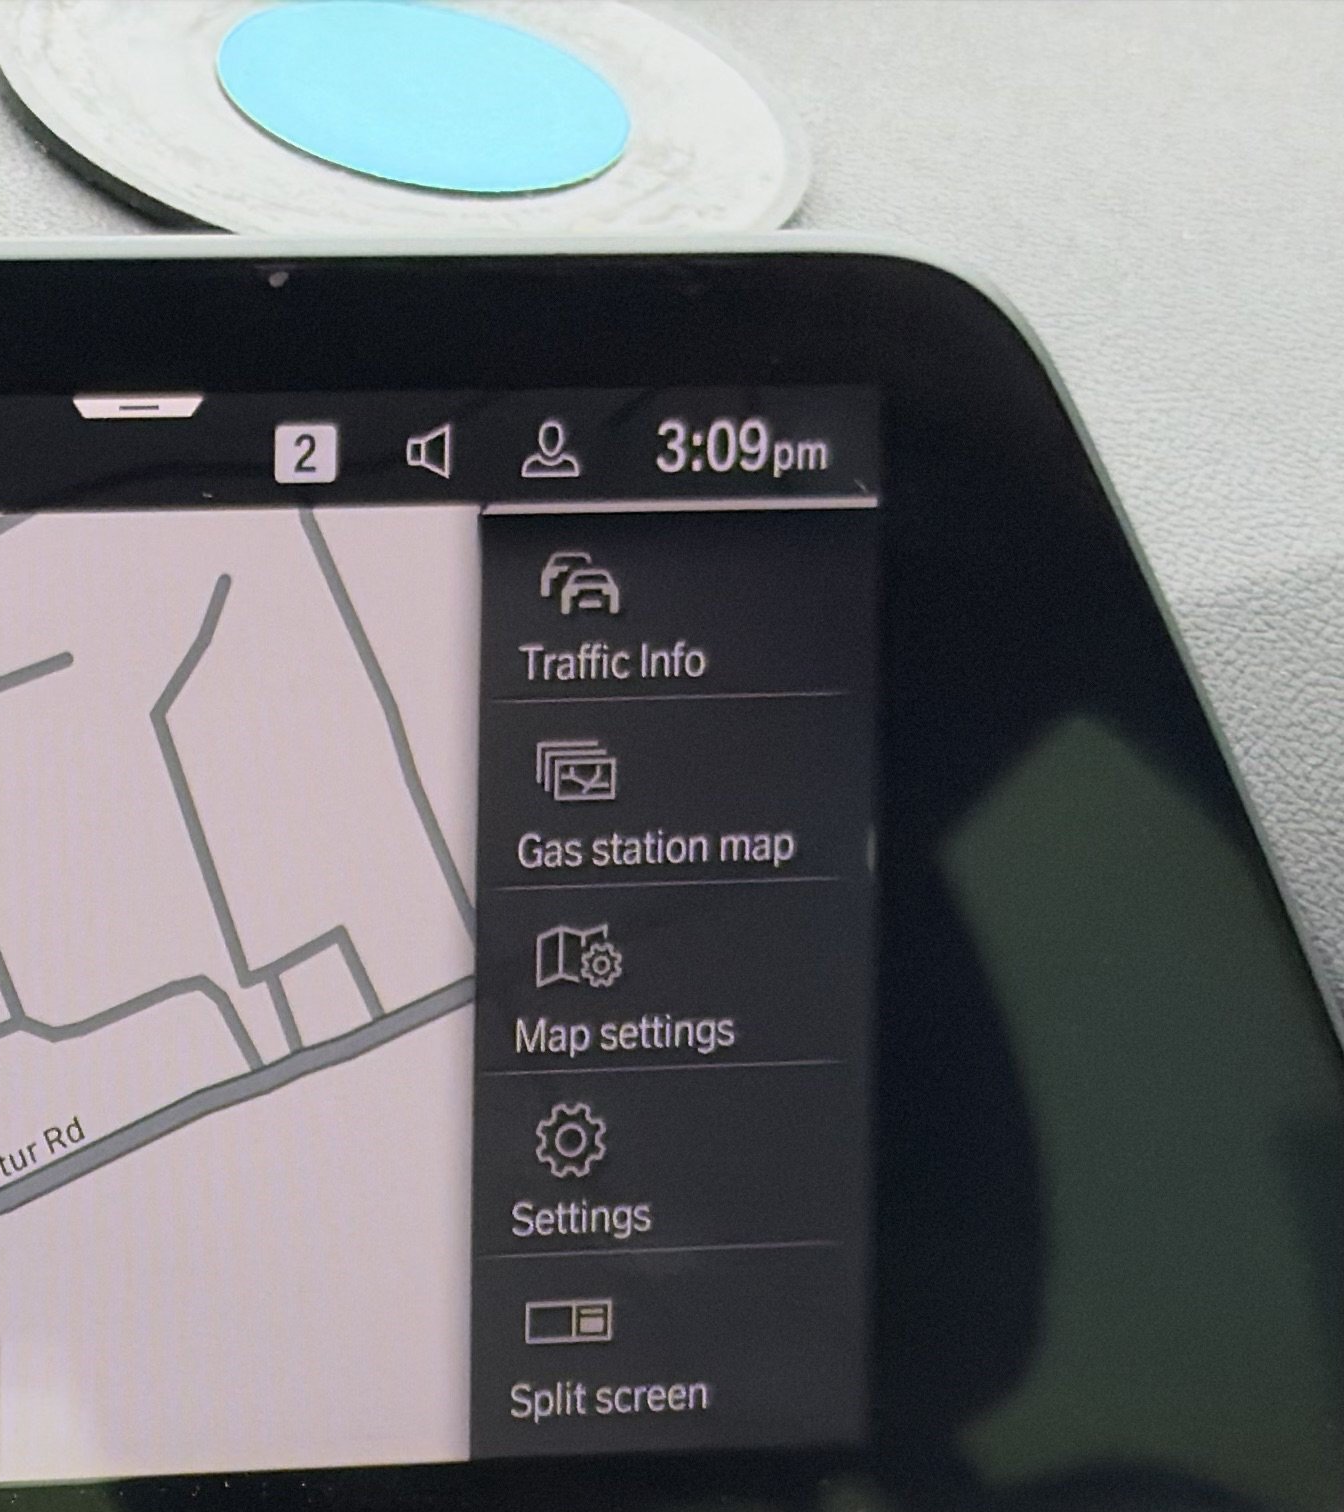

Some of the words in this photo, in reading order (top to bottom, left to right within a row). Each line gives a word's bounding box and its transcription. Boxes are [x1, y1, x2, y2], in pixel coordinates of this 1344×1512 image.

[293, 435, 317, 474] 2
[656, 419, 828, 478] 3:09pm
[520, 643, 630, 681] Traffic
[641, 643, 707, 679] Info
[519, 834, 582, 868] Gas
[592, 831, 708, 866] station
[721, 835, 795, 868] map
[516, 1018, 590, 1058] Map
[601, 1015, 735, 1055] settings
[43, 1118, 86, 1156] Rd
[512, 1197, 651, 1239] Settings
[511, 1381, 586, 1424] Split
[596, 1379, 710, 1412] screen
